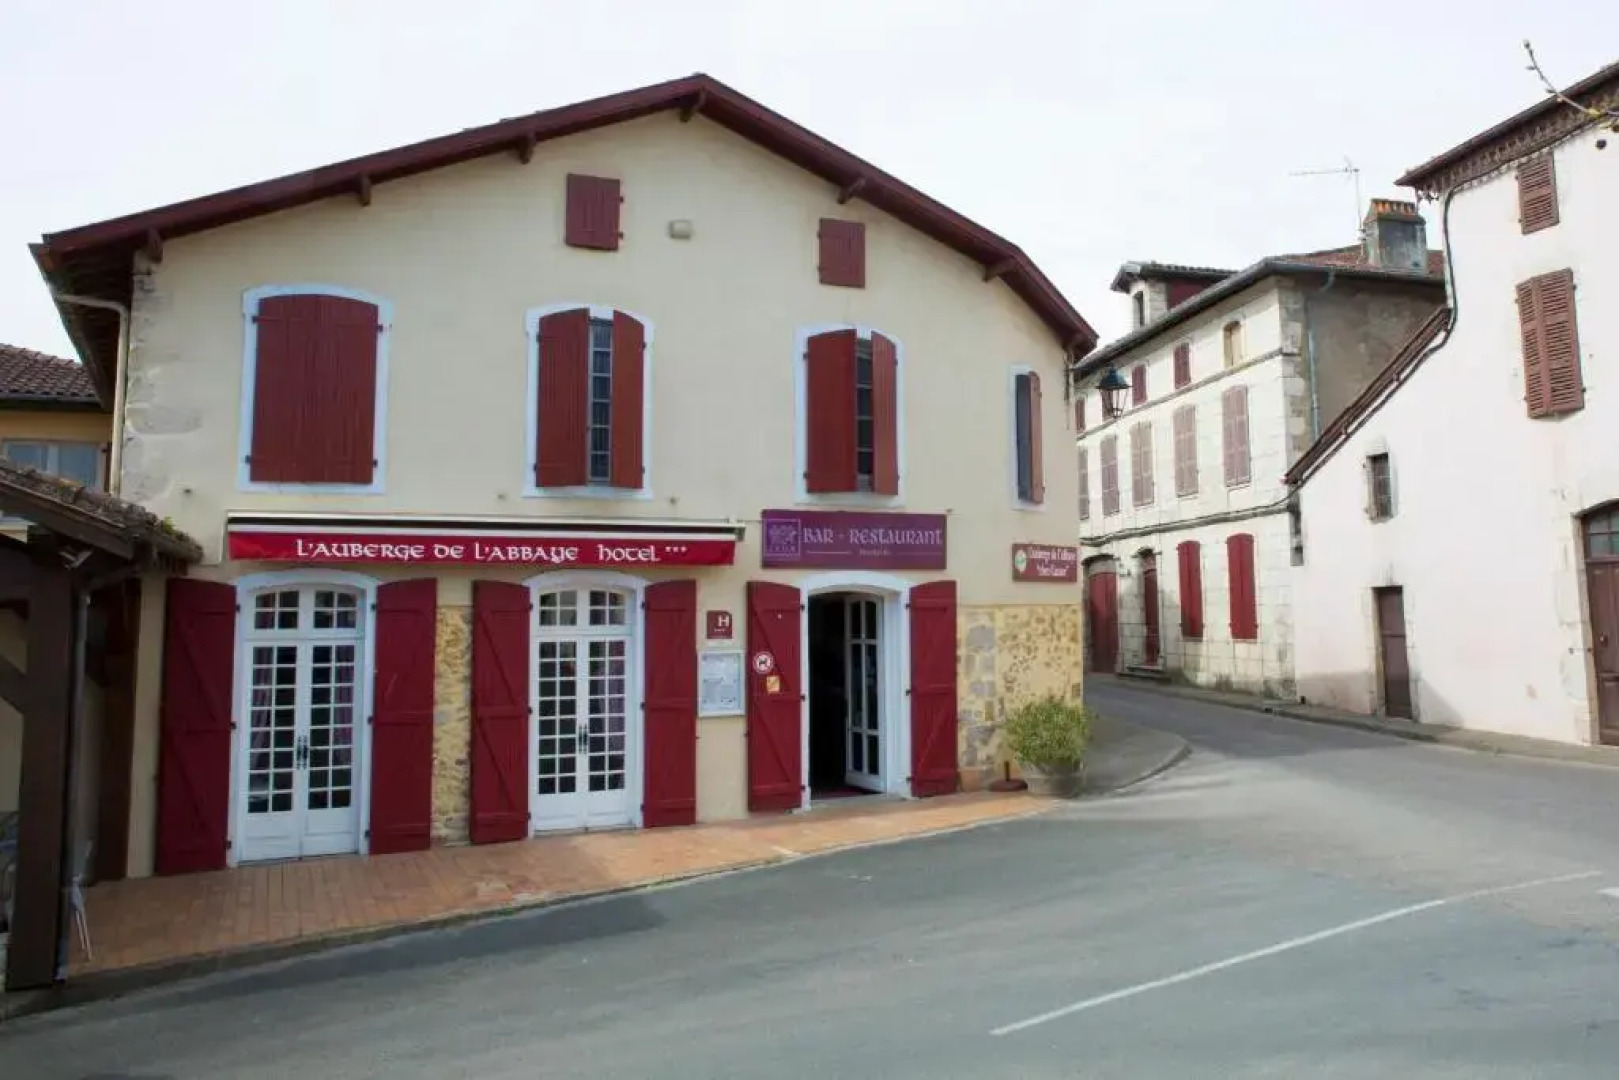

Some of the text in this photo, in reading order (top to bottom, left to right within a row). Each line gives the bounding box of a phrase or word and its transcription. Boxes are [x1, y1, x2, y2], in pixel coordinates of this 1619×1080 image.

[803, 527, 834, 544] BAR
[849, 527, 943, 546] RESTAURANT
[296, 538, 425, 561] L'AUBERGE
[433, 543, 465, 559] DE
[474, 542, 579, 563] L'ABBAYE
[718, 615, 730, 627] H
